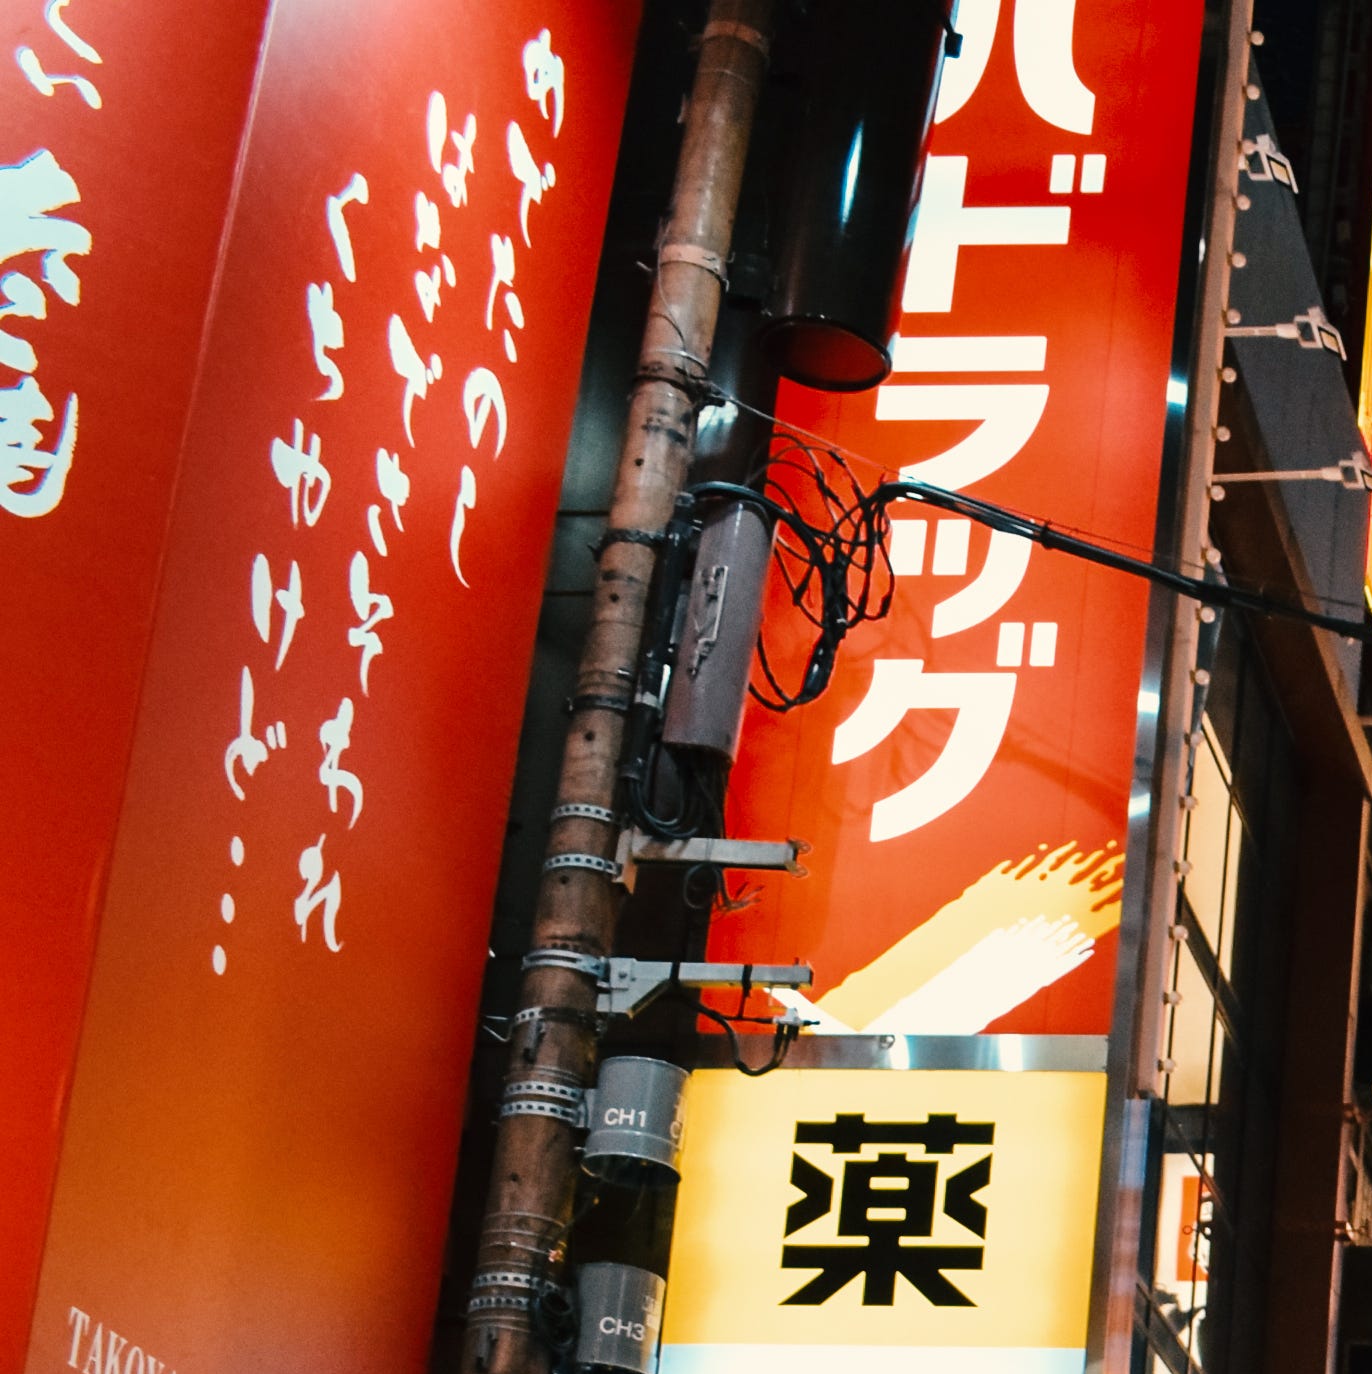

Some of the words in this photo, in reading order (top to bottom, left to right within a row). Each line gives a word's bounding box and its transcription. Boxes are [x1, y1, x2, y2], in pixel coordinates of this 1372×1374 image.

[605, 1108, 647, 1128] CH1
[778, 1113, 995, 1306] 薬
[599, 1316, 645, 1342] CH3
